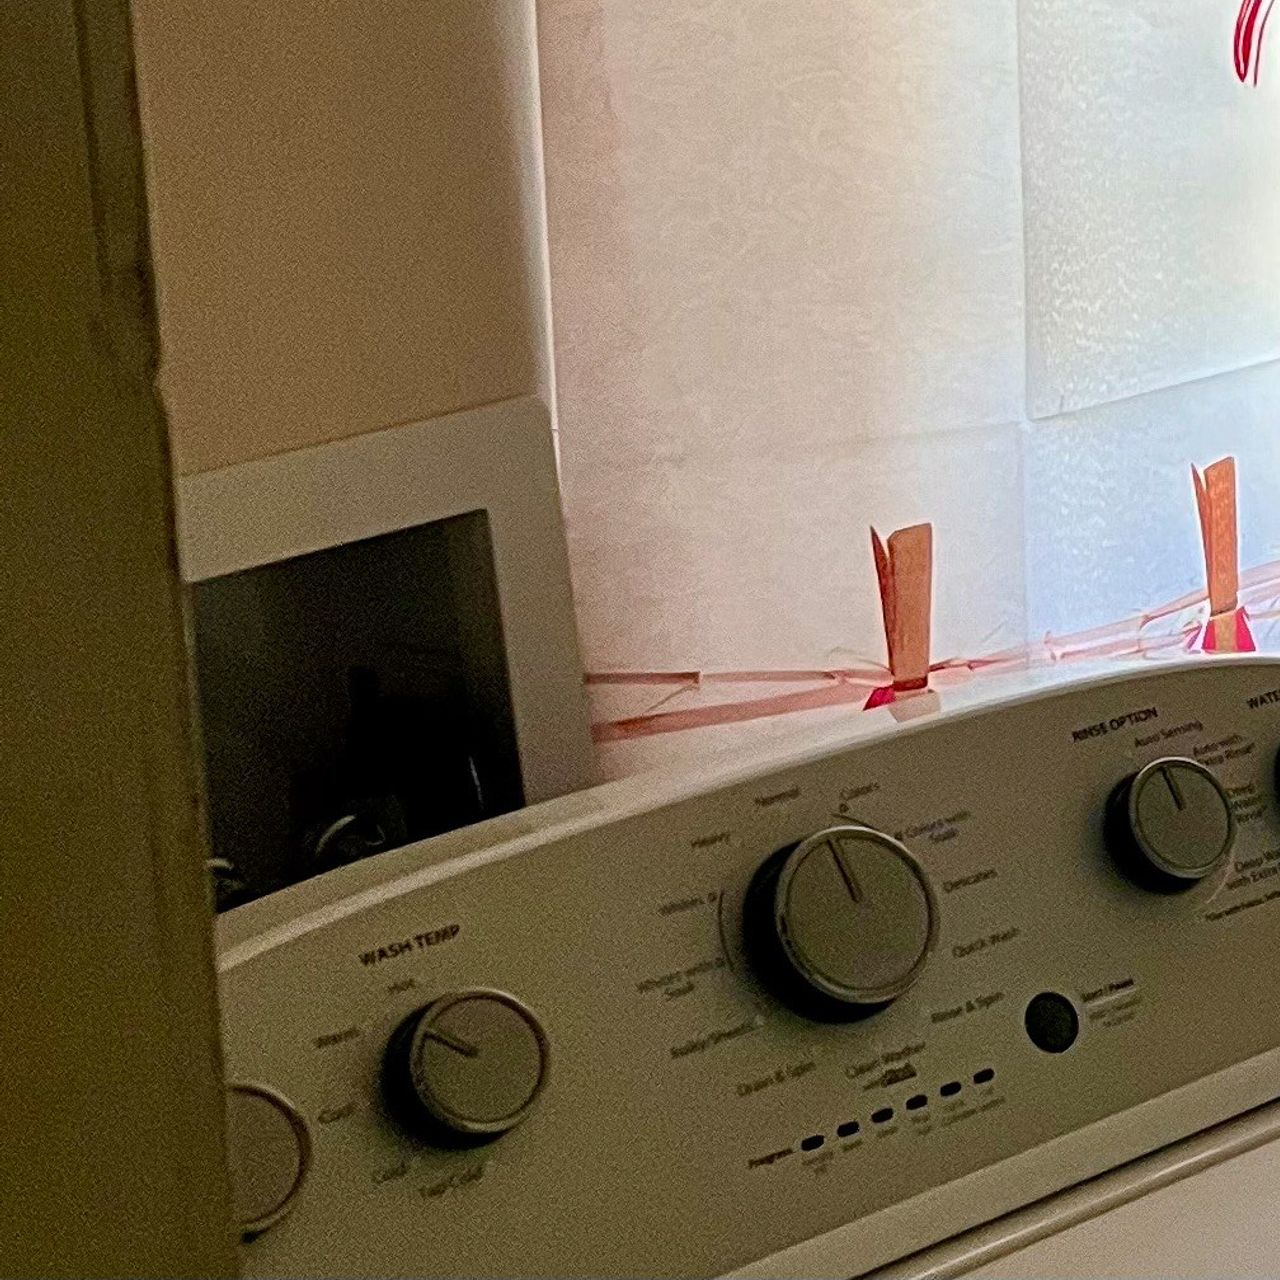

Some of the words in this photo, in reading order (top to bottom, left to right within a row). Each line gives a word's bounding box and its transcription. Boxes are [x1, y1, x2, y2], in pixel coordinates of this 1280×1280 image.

[1072, 723, 1107, 743] RINSE
[1109, 706, 1159, 731] OPTION
[358, 939, 413, 967] WASH
[413, 923, 461, 950] TEMP
